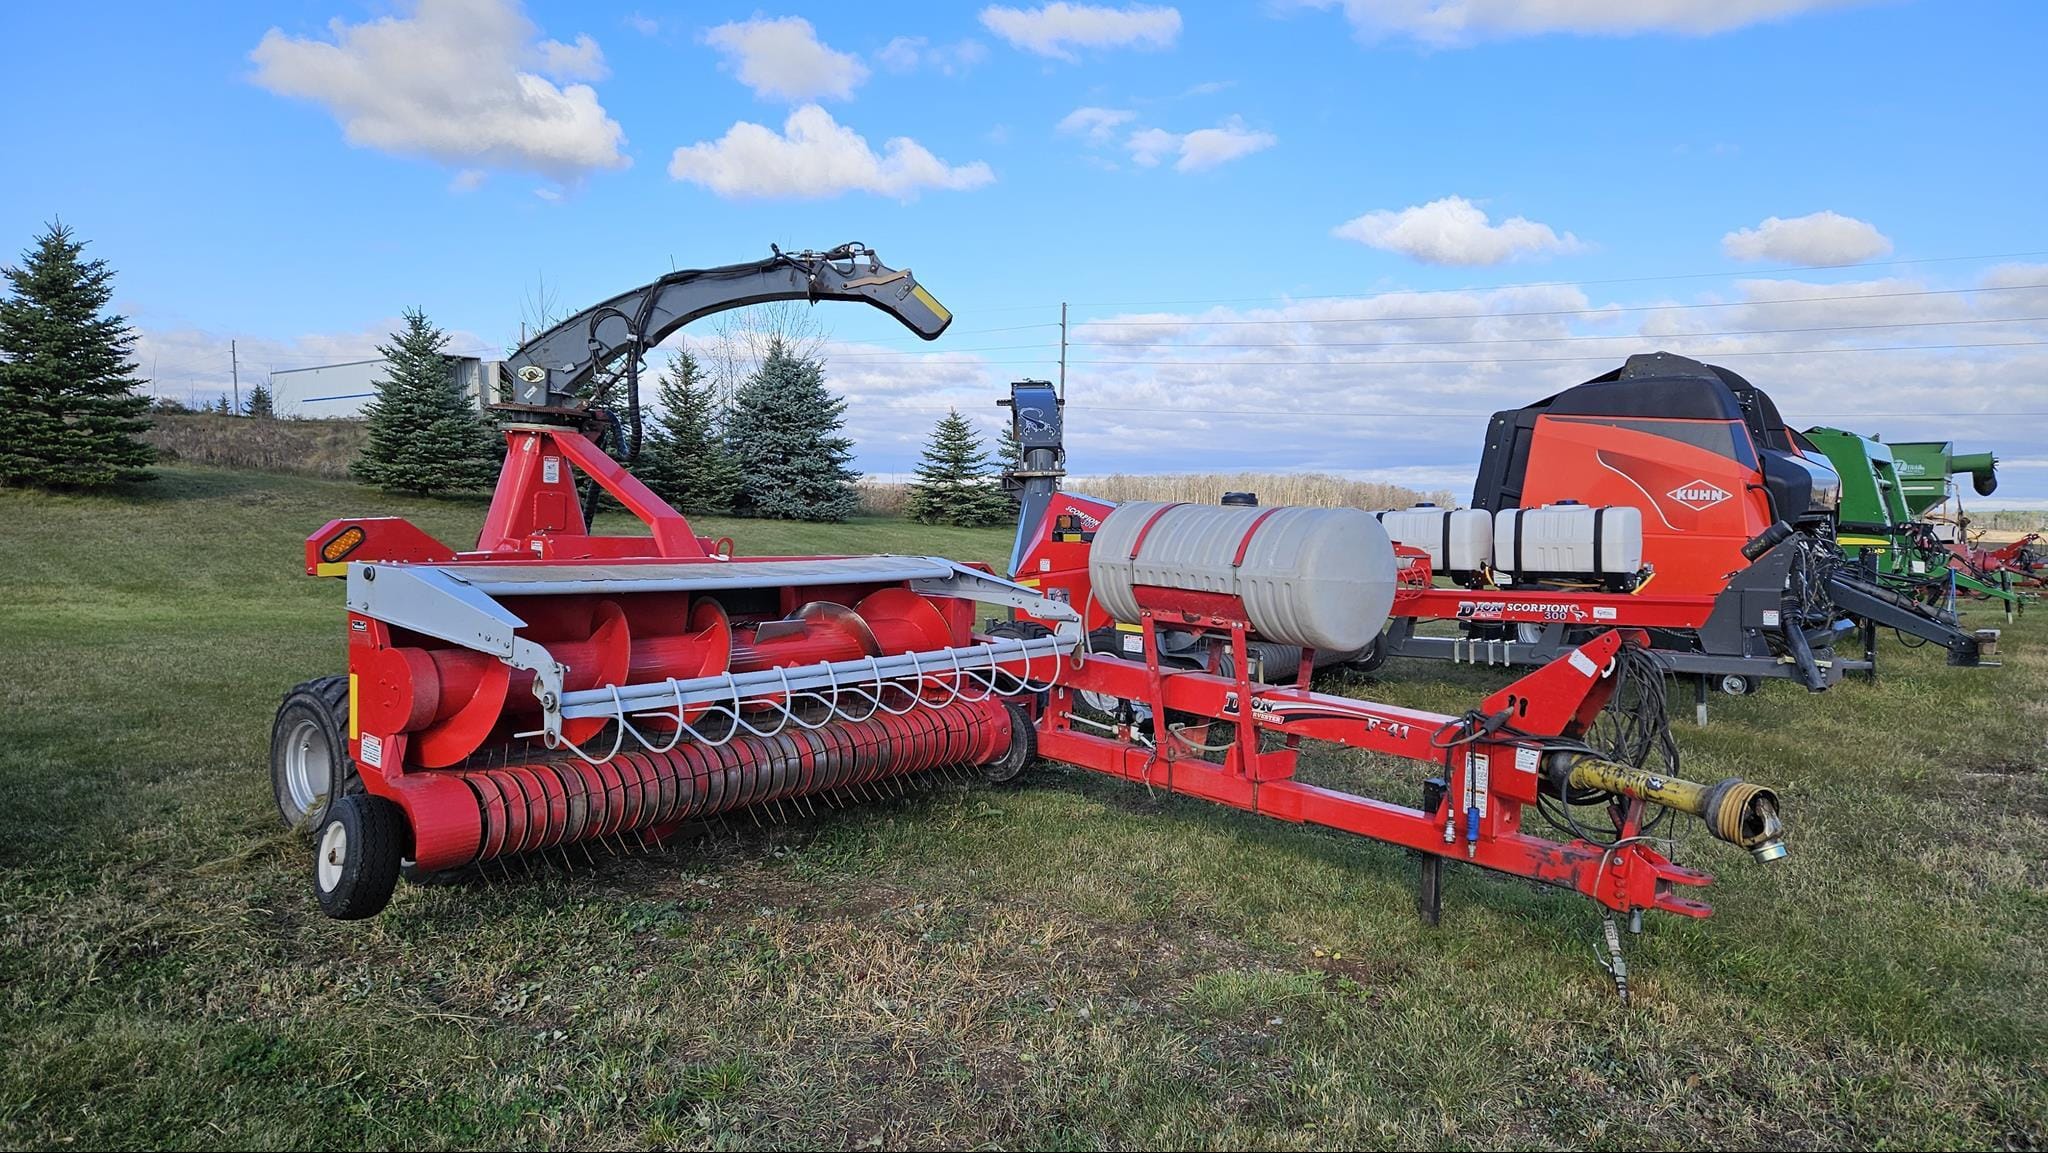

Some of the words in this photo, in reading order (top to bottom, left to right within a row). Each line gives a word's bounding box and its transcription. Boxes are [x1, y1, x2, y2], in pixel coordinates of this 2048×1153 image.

[1676, 488, 1723, 501] KUHN
[1065, 505, 1101, 526] SCORPION
[1456, 601, 1506, 618] DION
[1507, 603, 1570, 613] SCORPION
[1544, 611, 1567, 620] 300
[1223, 692, 1276, 715] DON
[1365, 718, 1410, 740] F-41
